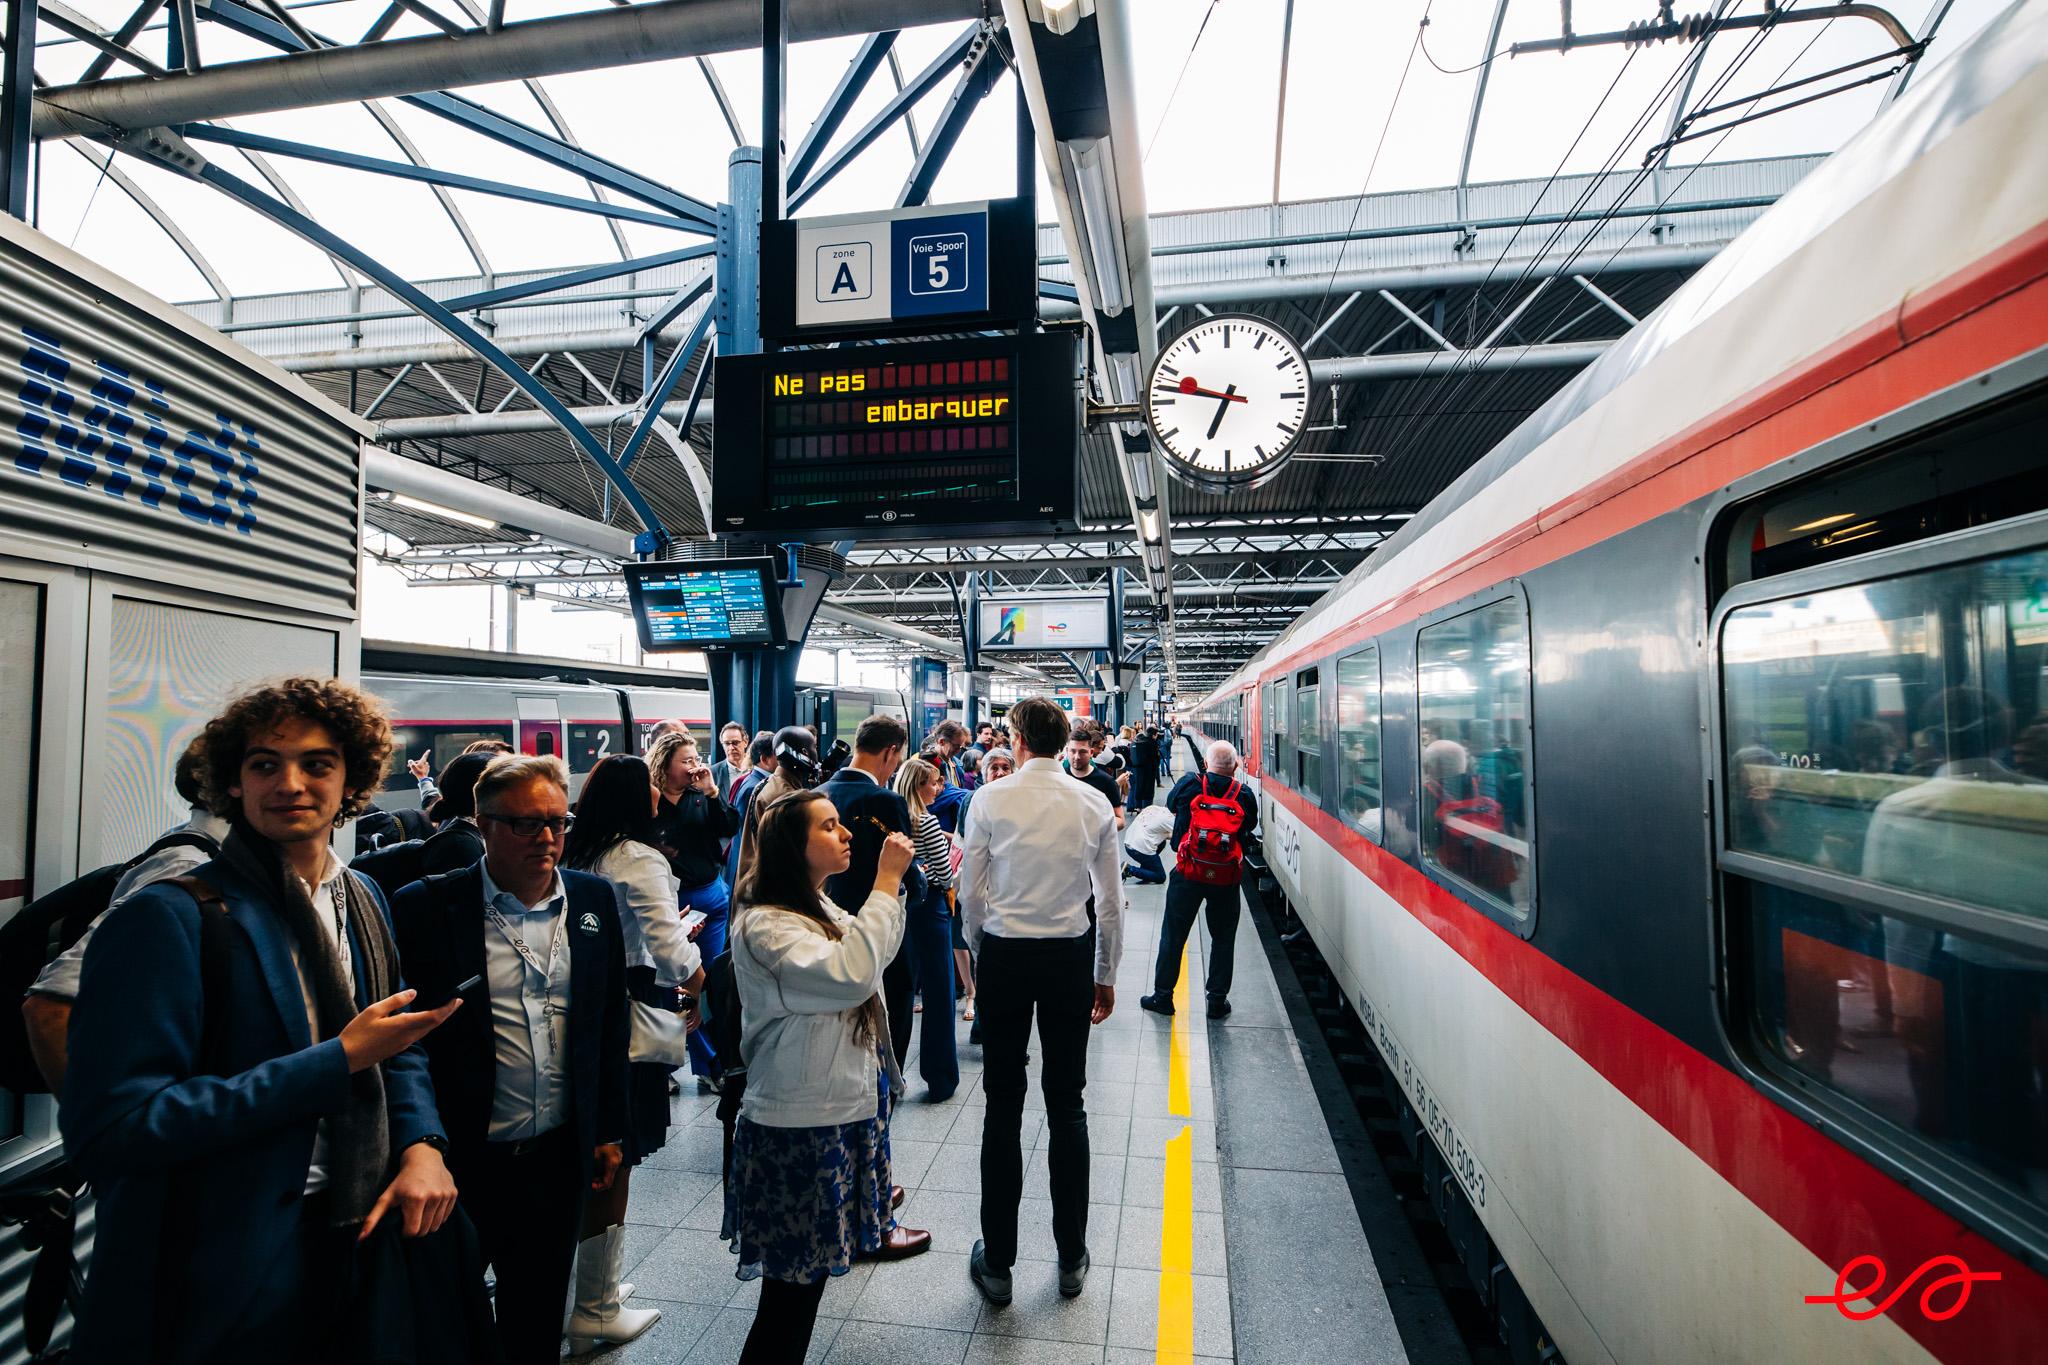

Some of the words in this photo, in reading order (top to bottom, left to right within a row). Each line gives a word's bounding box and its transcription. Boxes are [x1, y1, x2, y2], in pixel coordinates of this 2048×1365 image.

[832, 249, 855, 259] zone
[912, 243, 934, 254] Voie
[936, 240, 965, 253] Spoor
[831, 262, 857, 294] A
[928, 255, 949, 289] 5
[774, 374, 804, 397] Ne
[820, 373, 866, 393] pas
[867, 397, 1009, 423] embarquer
[15, 326, 260, 537] Midi
[640, 723, 653, 732] TGV
[597, 729, 610, 759] 2
[1379, 1022, 1400, 1072] Bcmh
[1404, 1059, 1412, 1092] 51
[1416, 1077, 1426, 1113] 56
[1428, 1097, 1454, 1158] 05-70
[1456, 1138, 1486, 1208] 508-3
